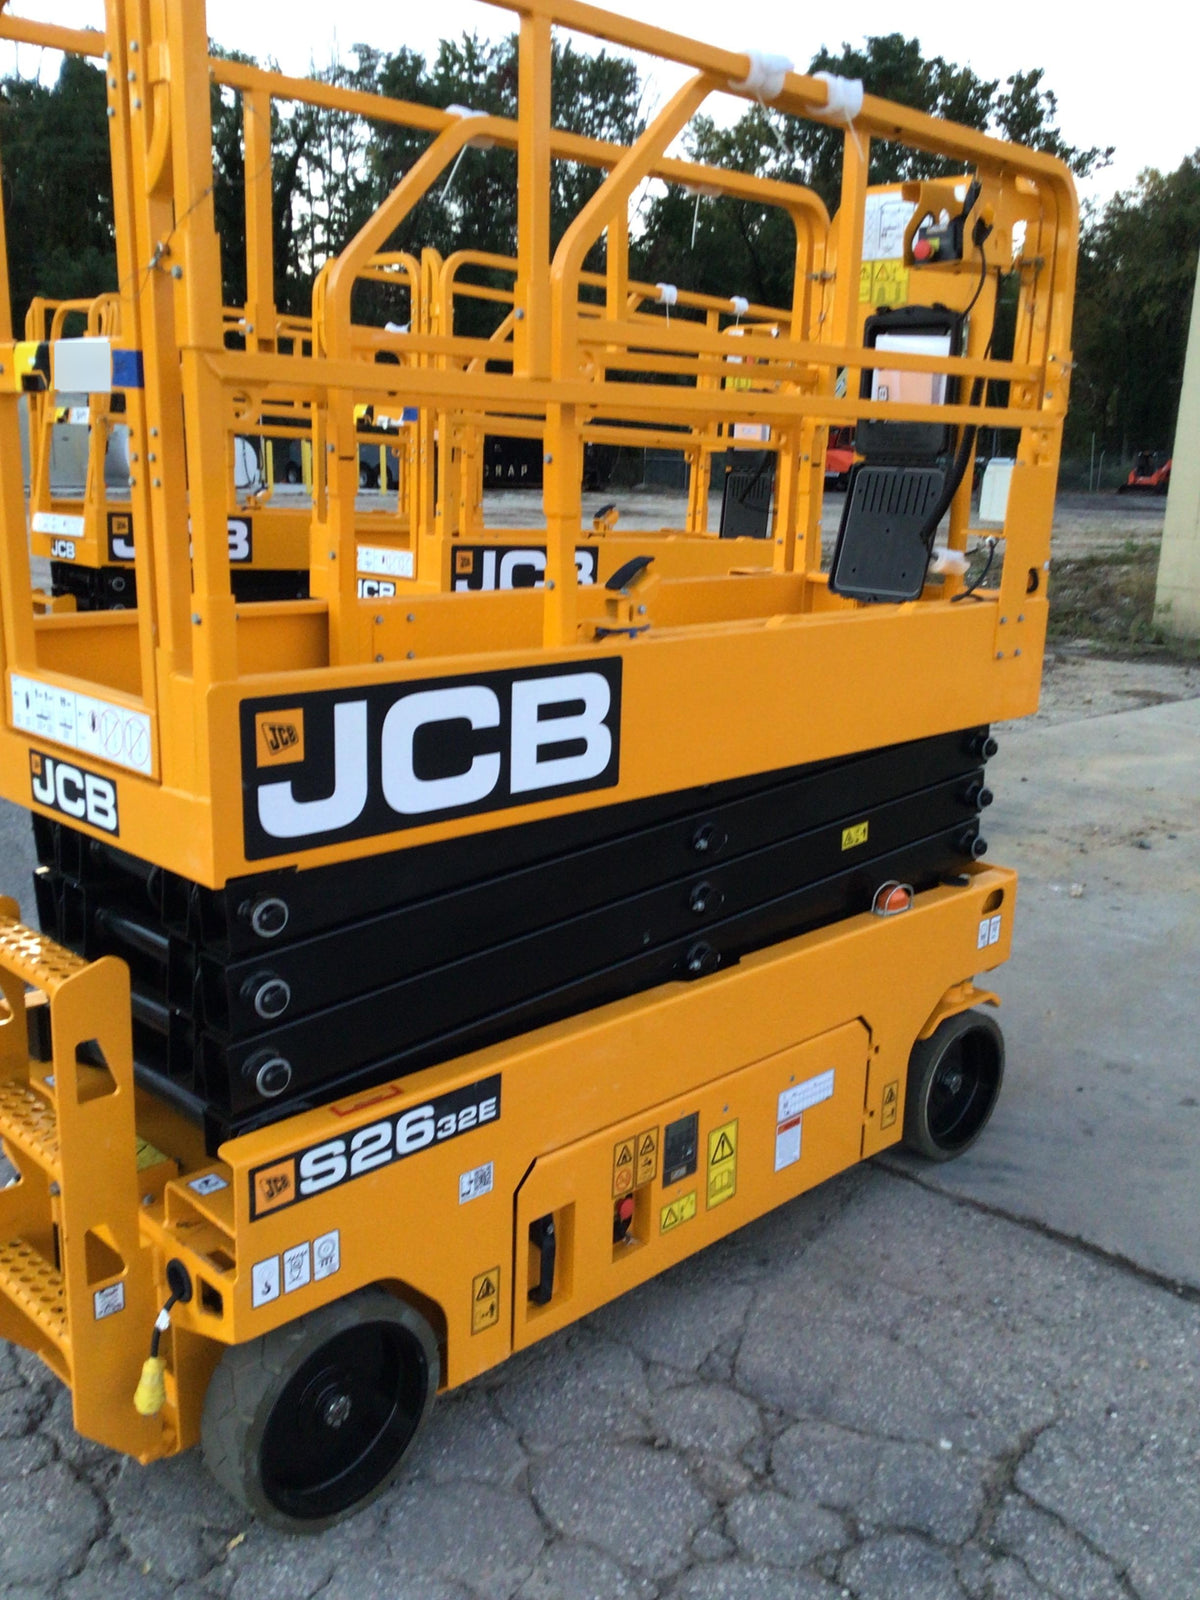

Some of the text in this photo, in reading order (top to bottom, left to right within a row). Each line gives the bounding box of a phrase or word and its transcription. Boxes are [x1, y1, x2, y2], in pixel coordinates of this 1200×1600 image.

[51, 539, 76, 560] JCB
[268, 724, 297, 751] JCB
[257, 671, 612, 839] JCB
[32, 757, 118, 832] JCB
[265, 1173, 290, 1198] JCB
